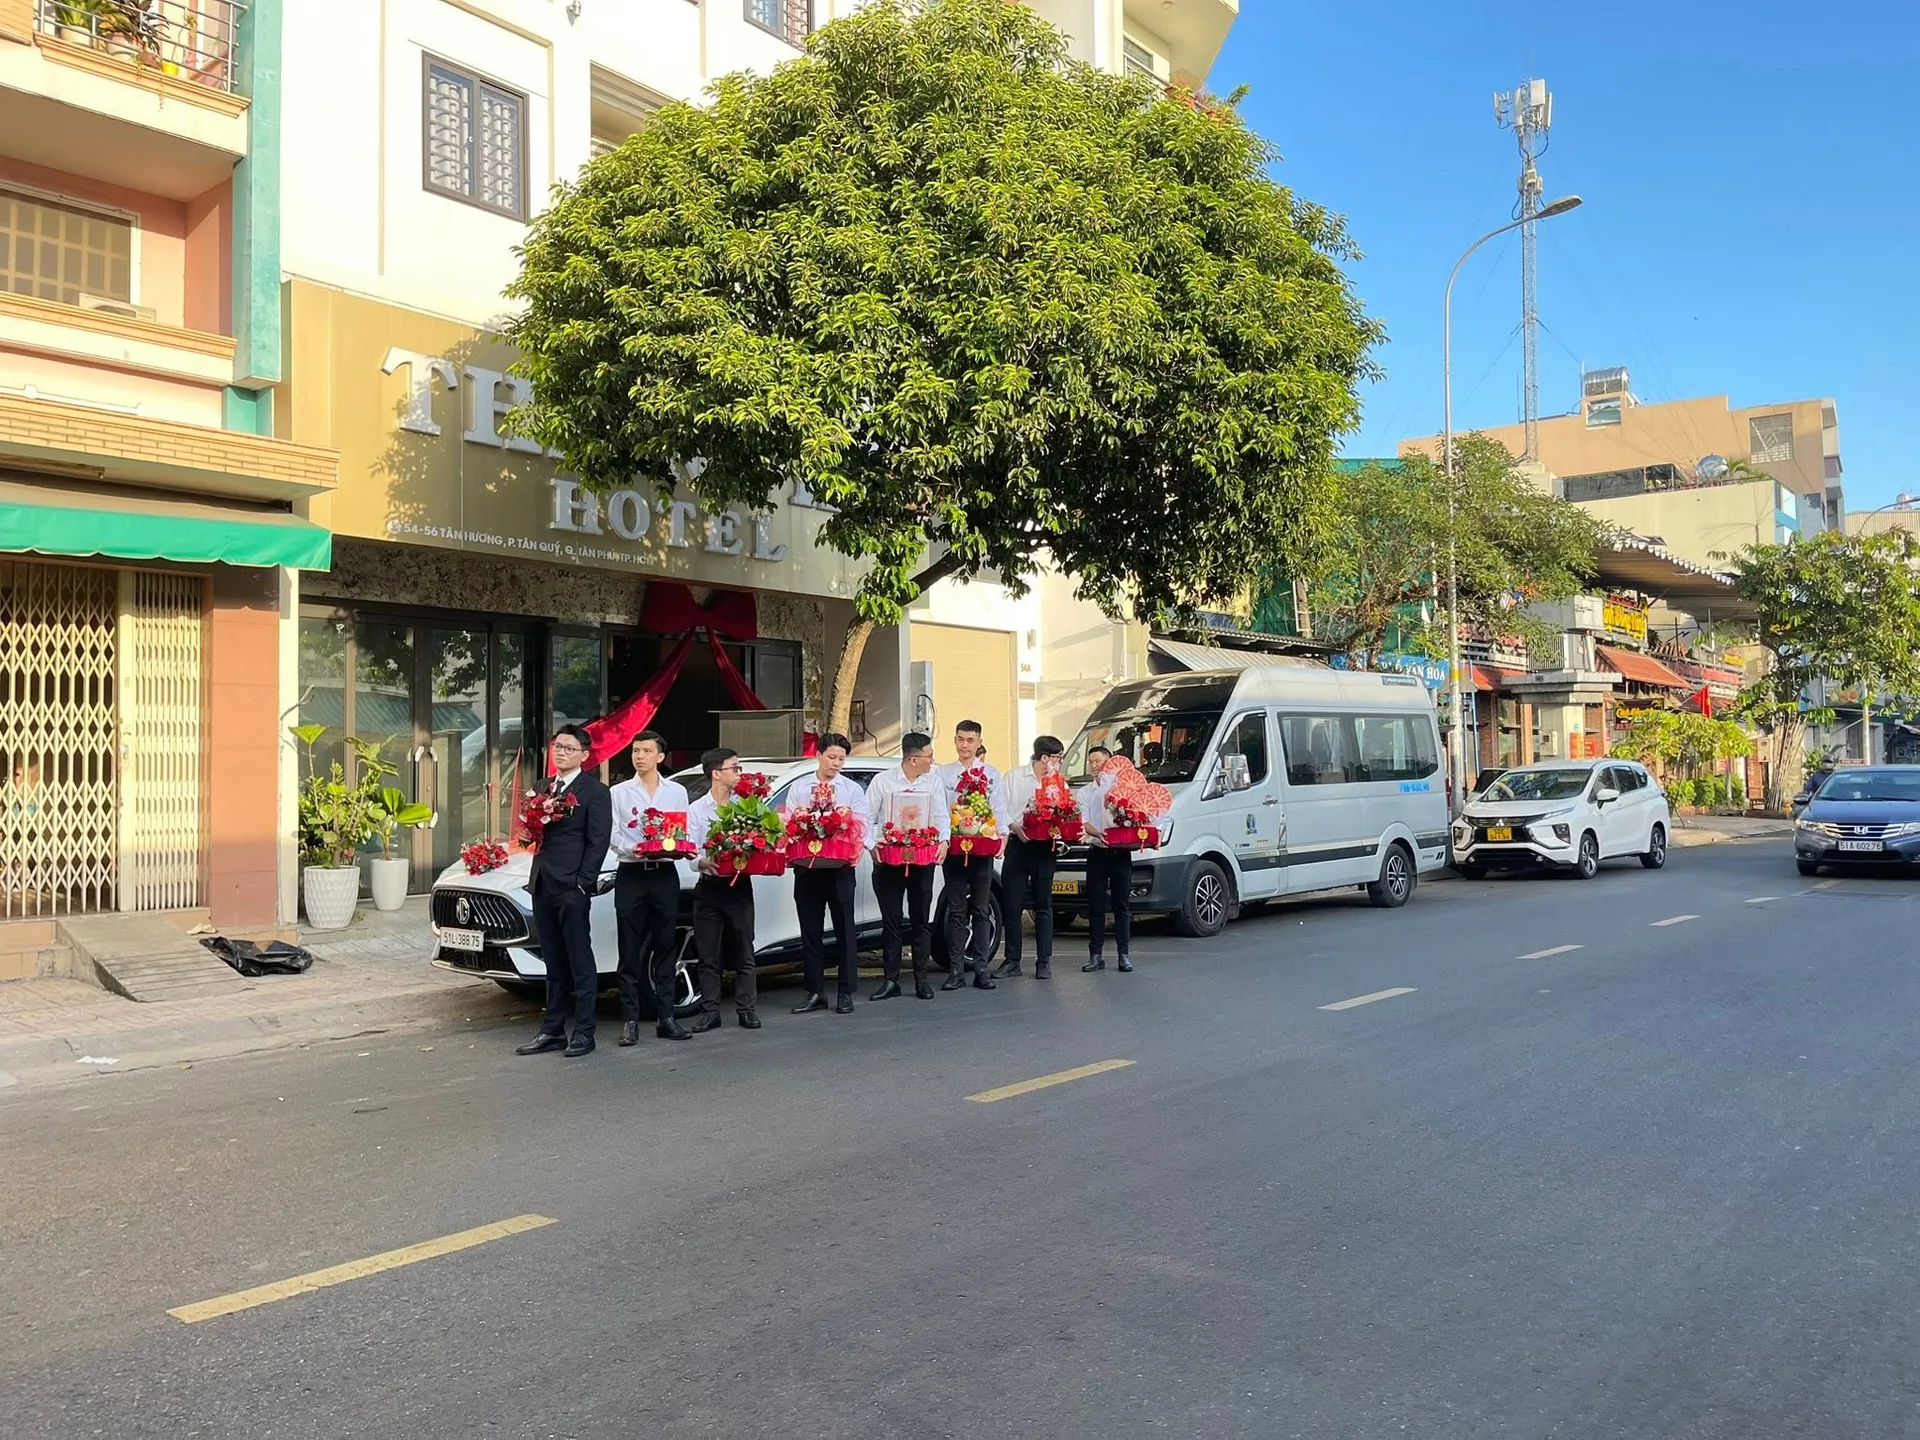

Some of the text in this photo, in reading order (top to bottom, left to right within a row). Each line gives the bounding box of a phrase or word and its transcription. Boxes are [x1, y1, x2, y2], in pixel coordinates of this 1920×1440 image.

[550, 477, 788, 563] HOTEL
[404, 523, 438, 537] 54-56
[440, 526, 462, 541] TÂN
[464, 531, 507, 548] HƯƠNG,
[508, 537, 516, 548] P.
[517, 538, 537, 551] TÂN
[539, 541, 564, 556] QUÝ,
[578, 546, 596, 559] TÂN
[1021, 663, 1031, 672] 54A
[1840, 841, 1855, 850] 51A
